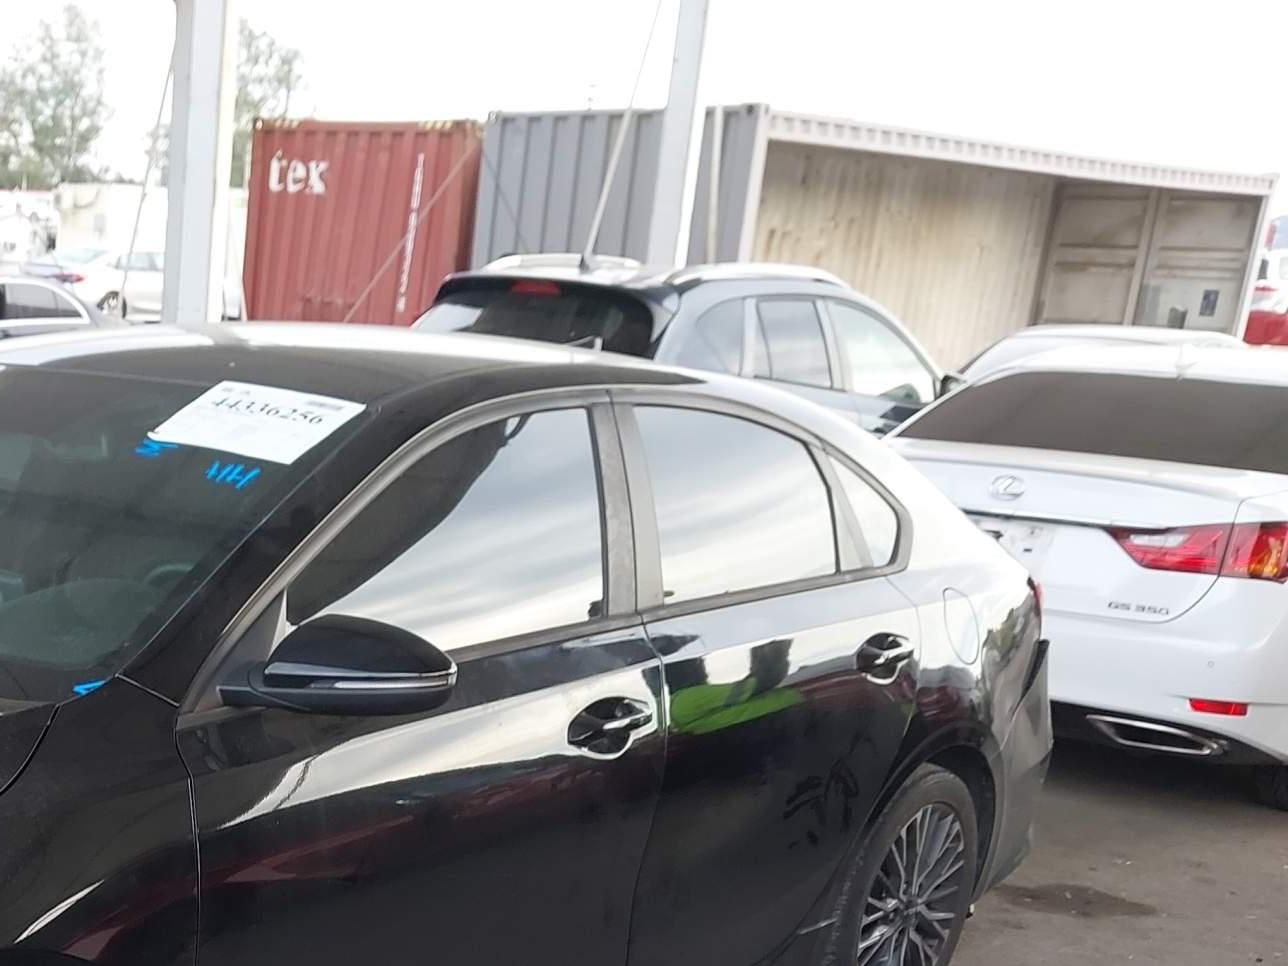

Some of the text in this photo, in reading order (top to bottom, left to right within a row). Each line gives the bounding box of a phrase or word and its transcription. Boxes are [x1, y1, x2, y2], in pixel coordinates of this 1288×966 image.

[268, 149, 329, 196] tex
[1107, 600, 1169, 616] GS 350
